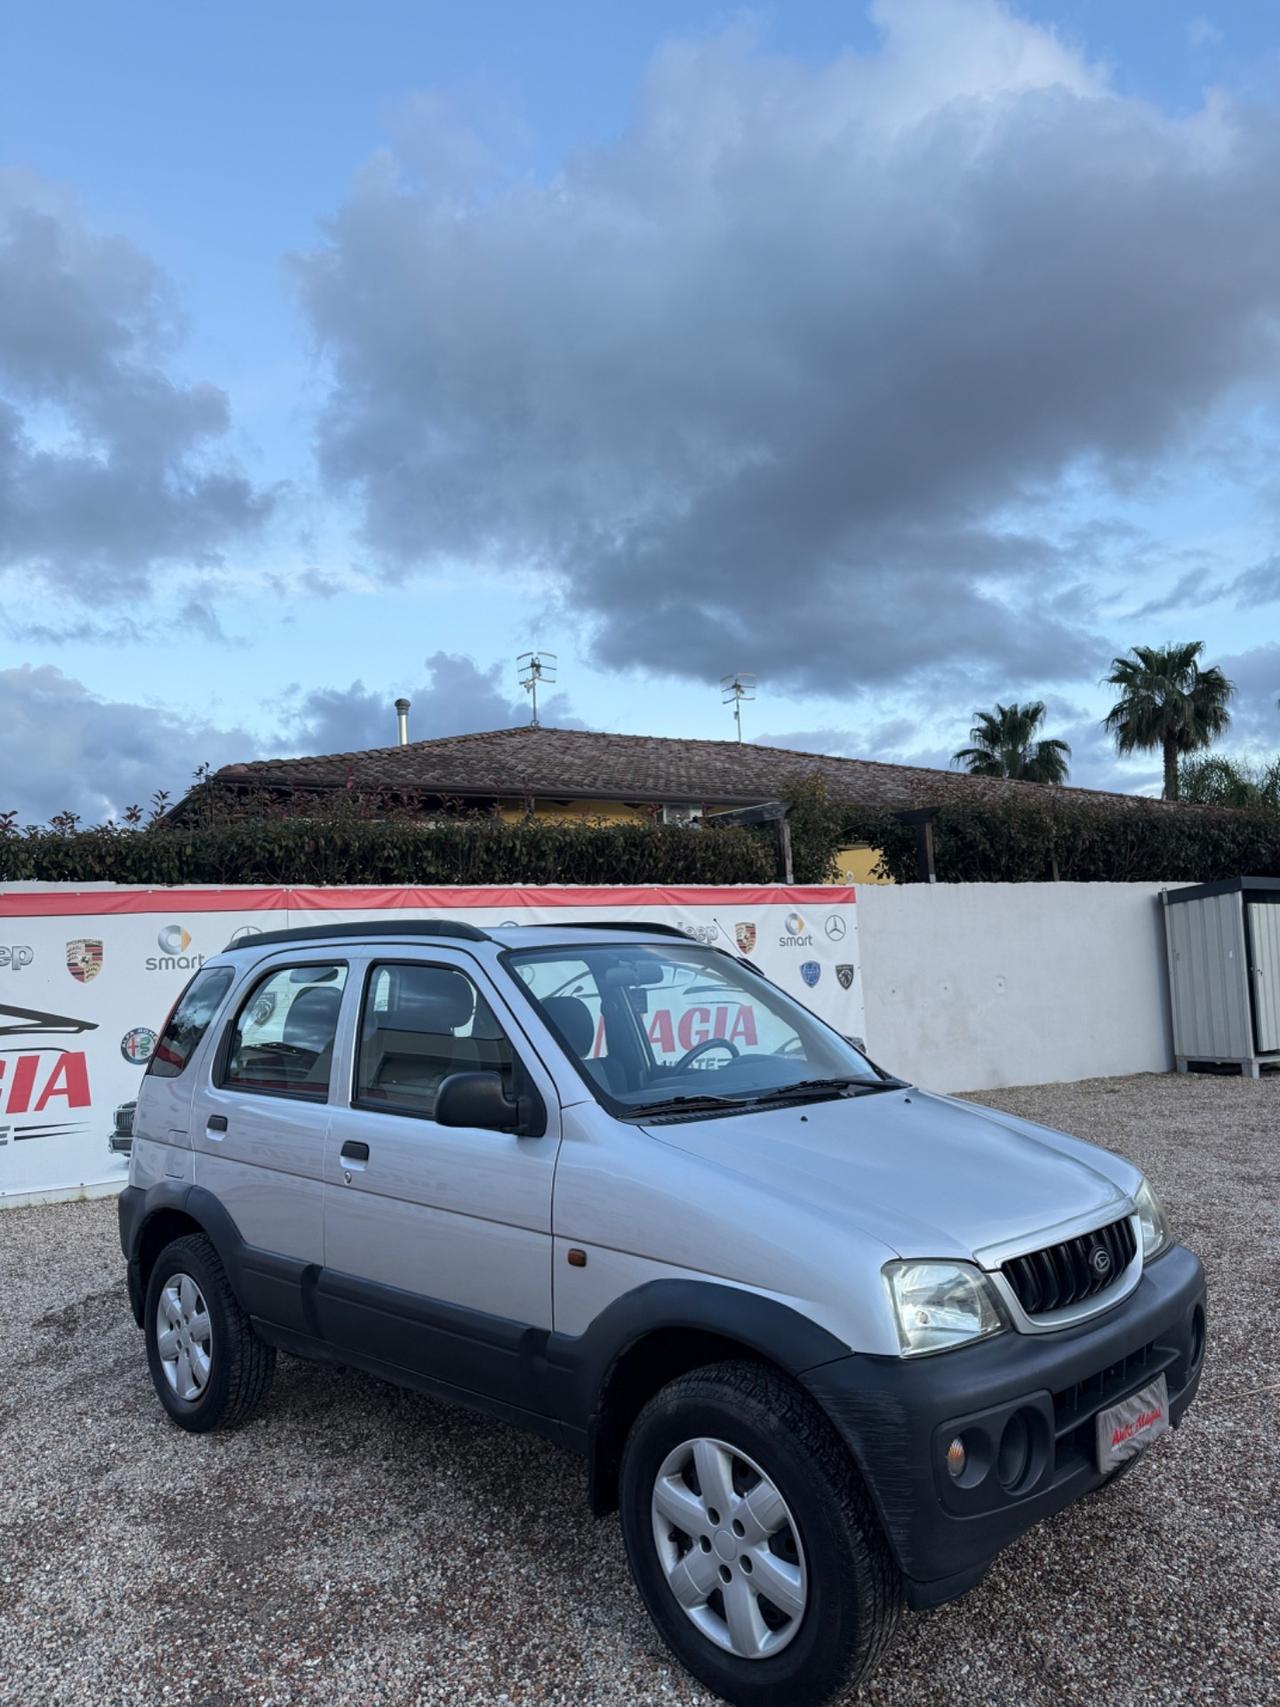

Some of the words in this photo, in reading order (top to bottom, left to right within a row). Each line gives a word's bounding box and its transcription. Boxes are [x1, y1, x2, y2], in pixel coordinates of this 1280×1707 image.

[779, 934, 814, 947] smart
[145, 953, 205, 971] smart
[0, 1051, 92, 1114] IA
